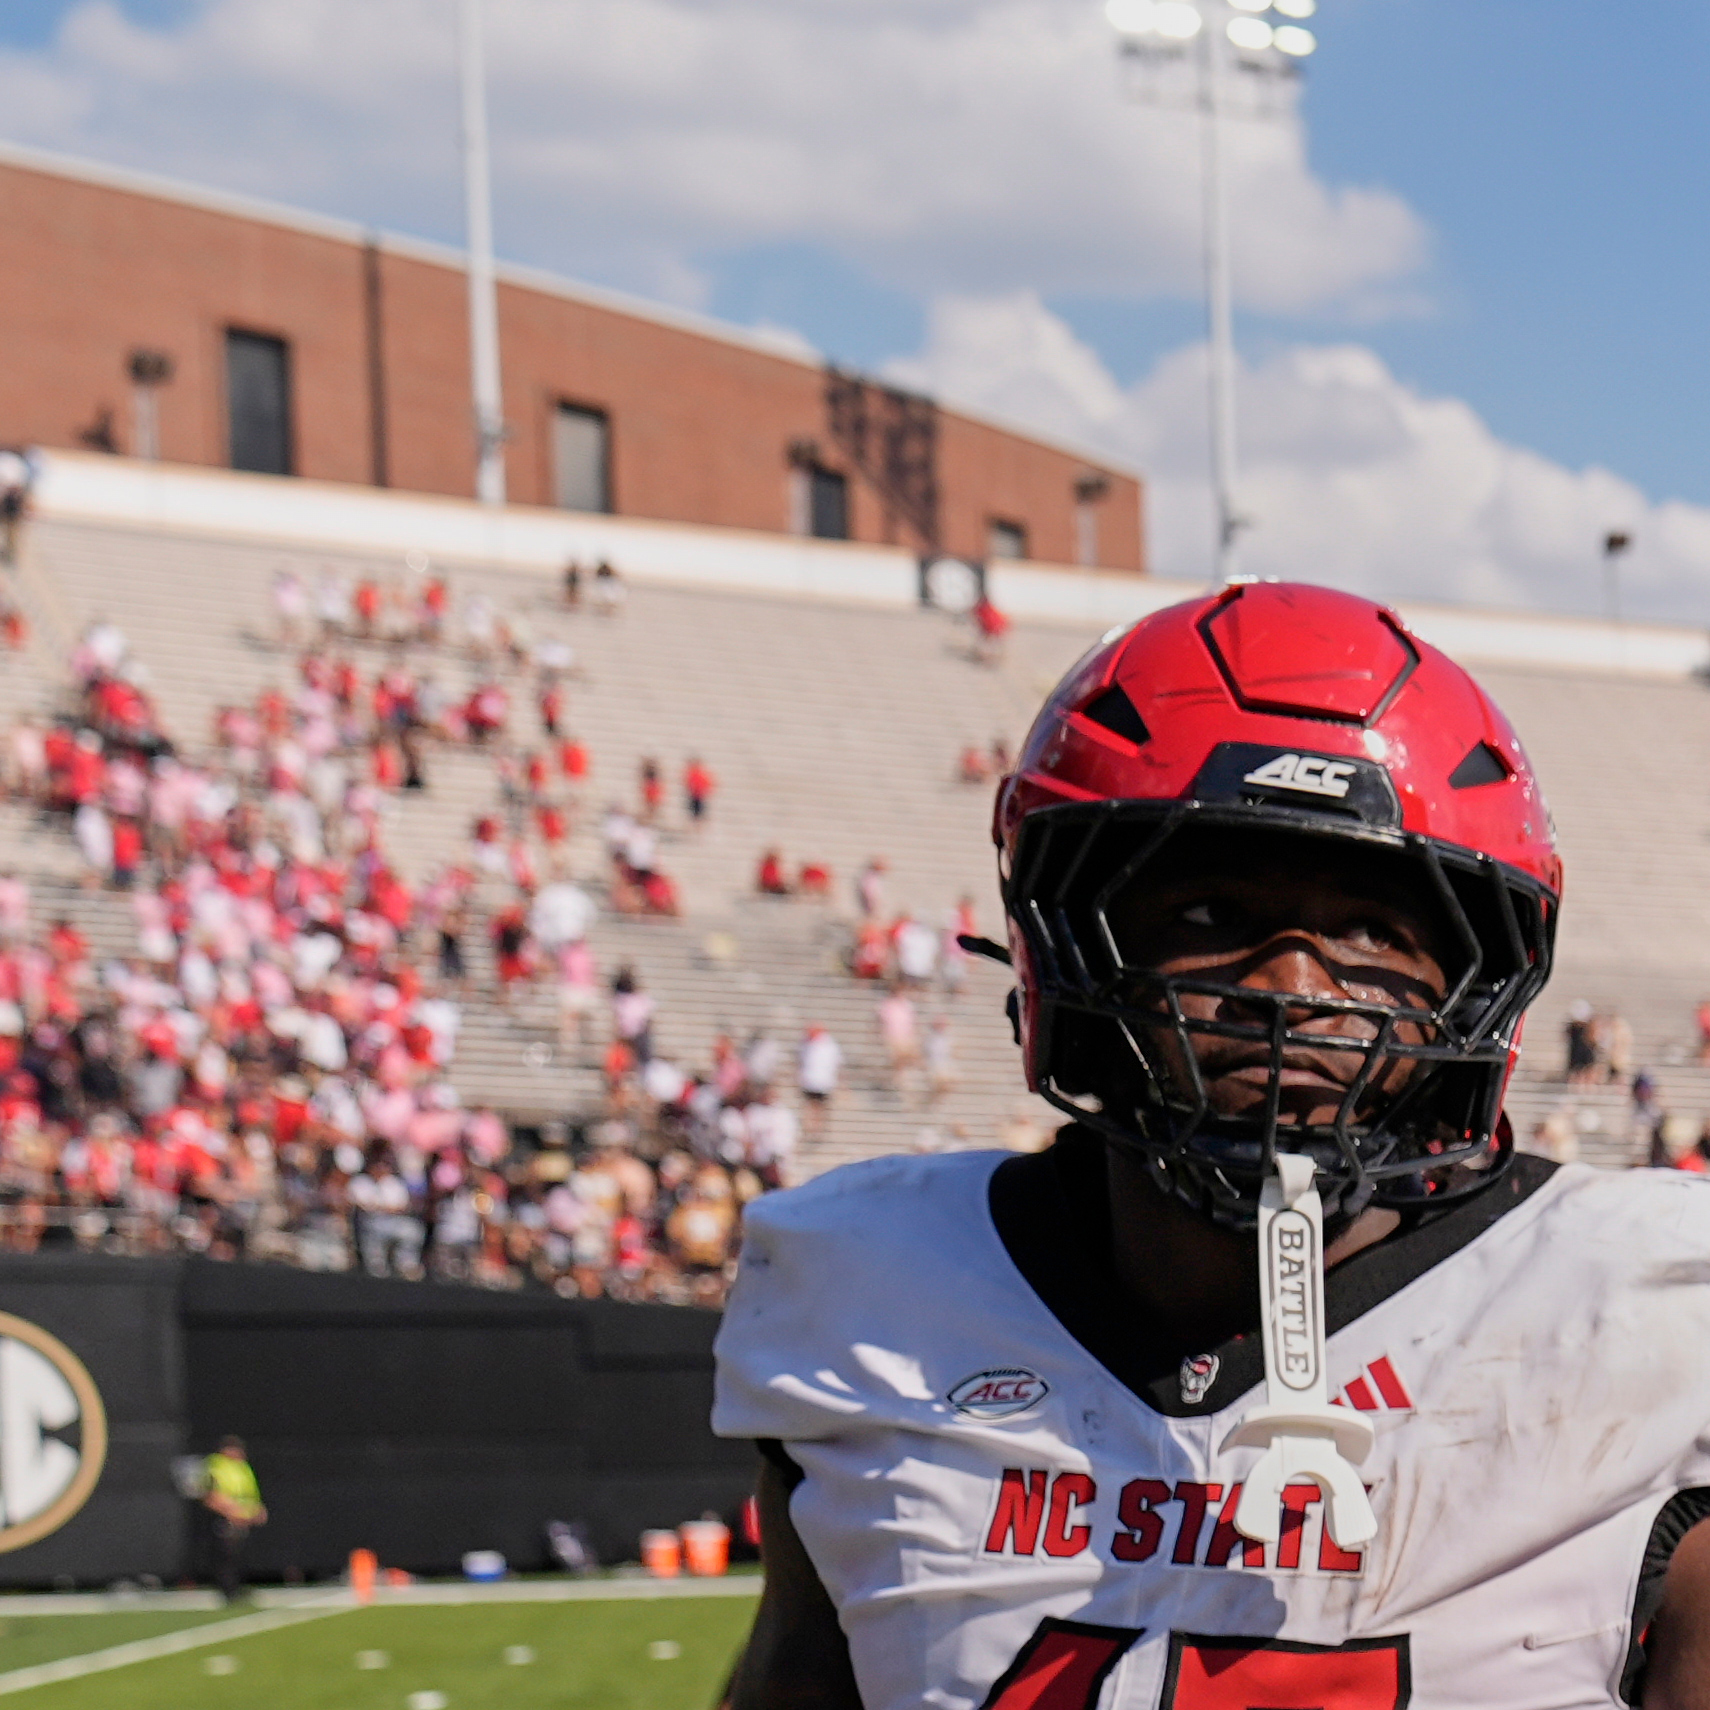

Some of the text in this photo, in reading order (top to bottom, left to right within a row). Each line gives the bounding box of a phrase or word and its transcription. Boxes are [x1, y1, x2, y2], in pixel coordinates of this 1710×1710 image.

[1243, 753, 1357, 798] ACC
[1278, 1227, 1310, 1374] BATTLE
[962, 1379, 1037, 1403] ACC
[984, 1468, 1098, 1559] NC
